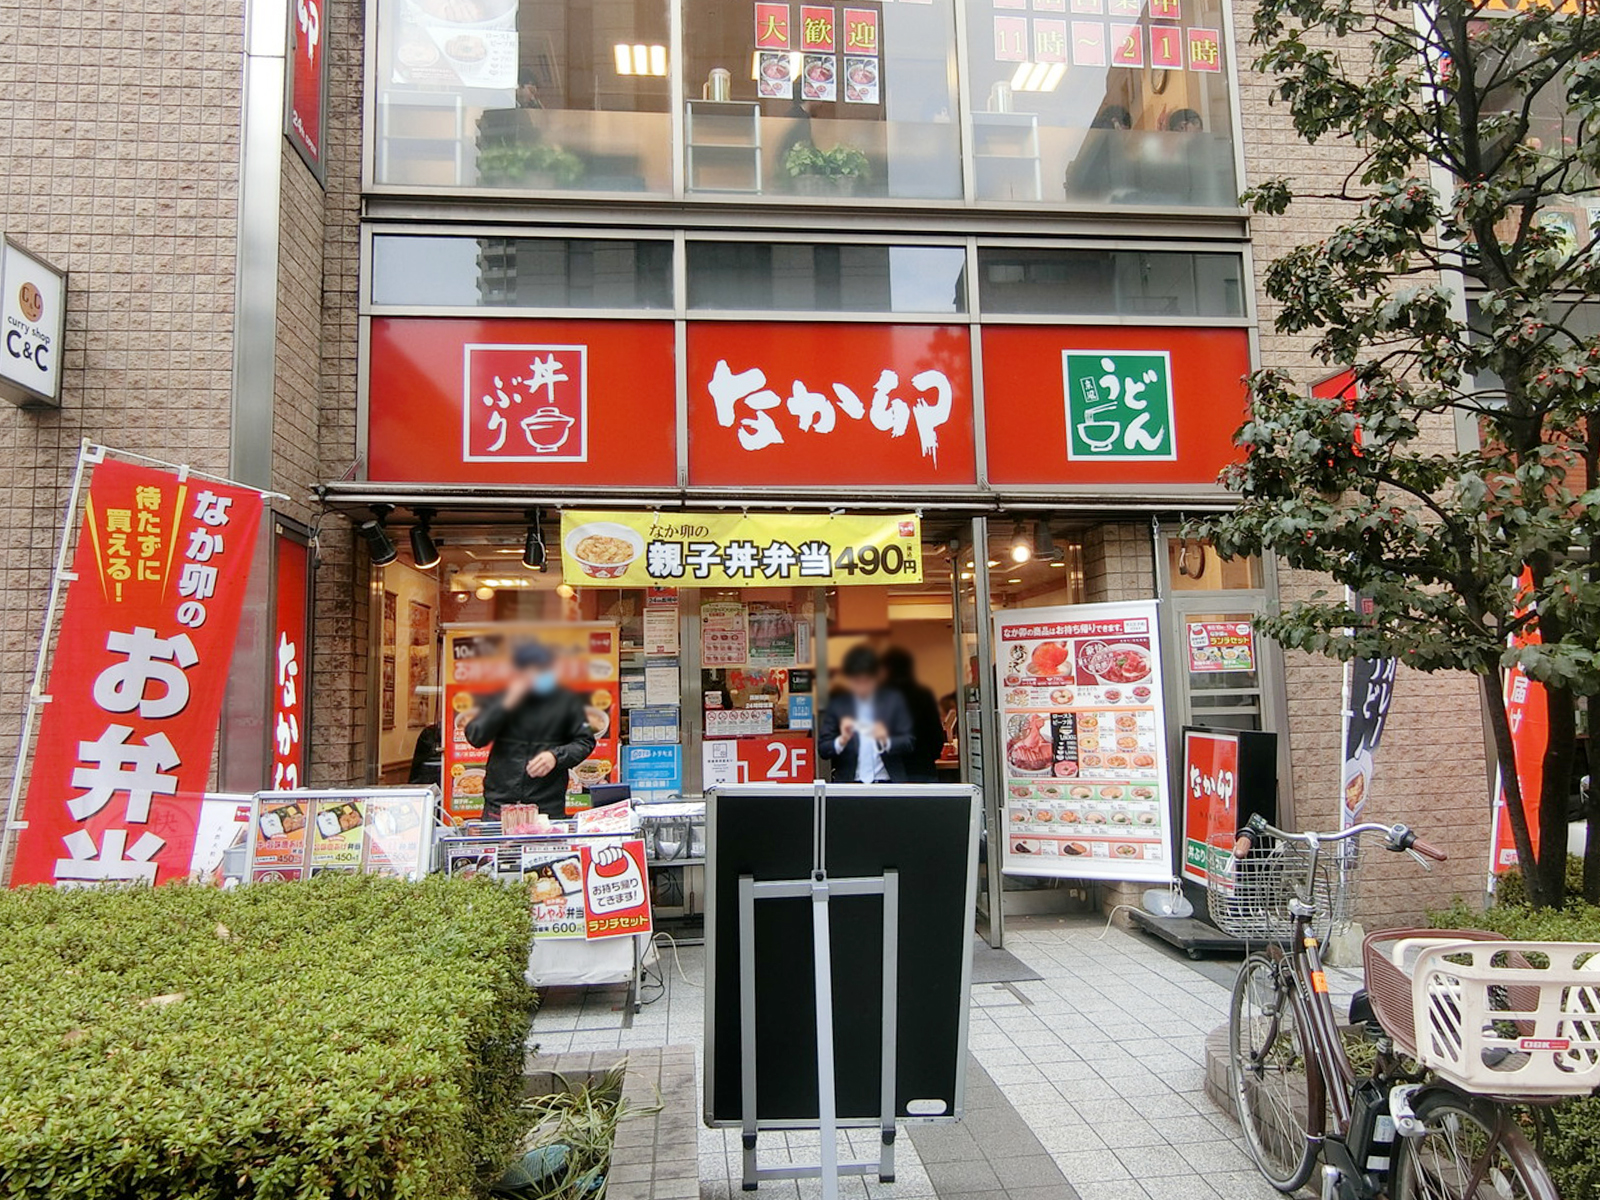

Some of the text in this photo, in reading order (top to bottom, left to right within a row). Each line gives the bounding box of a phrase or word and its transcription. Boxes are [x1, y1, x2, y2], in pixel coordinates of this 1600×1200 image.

[759, 15, 876, 48] 大歓迎
[7, 315, 51, 345] curry shop
[6, 329, 49, 372] C&C
[707, 359, 953, 471] なか卯
[1098, 357, 1166, 452] うどん
[136, 485, 161, 581] 待たずに
[649, 524, 709, 538] なか卯の
[176, 490, 233, 628] なか卯の
[766, 742, 807, 778] 2F
[1190, 763, 1234, 810] なか卯
[592, 878, 639, 896] お持ち帰り
[589, 914, 649, 932] ランチセット
